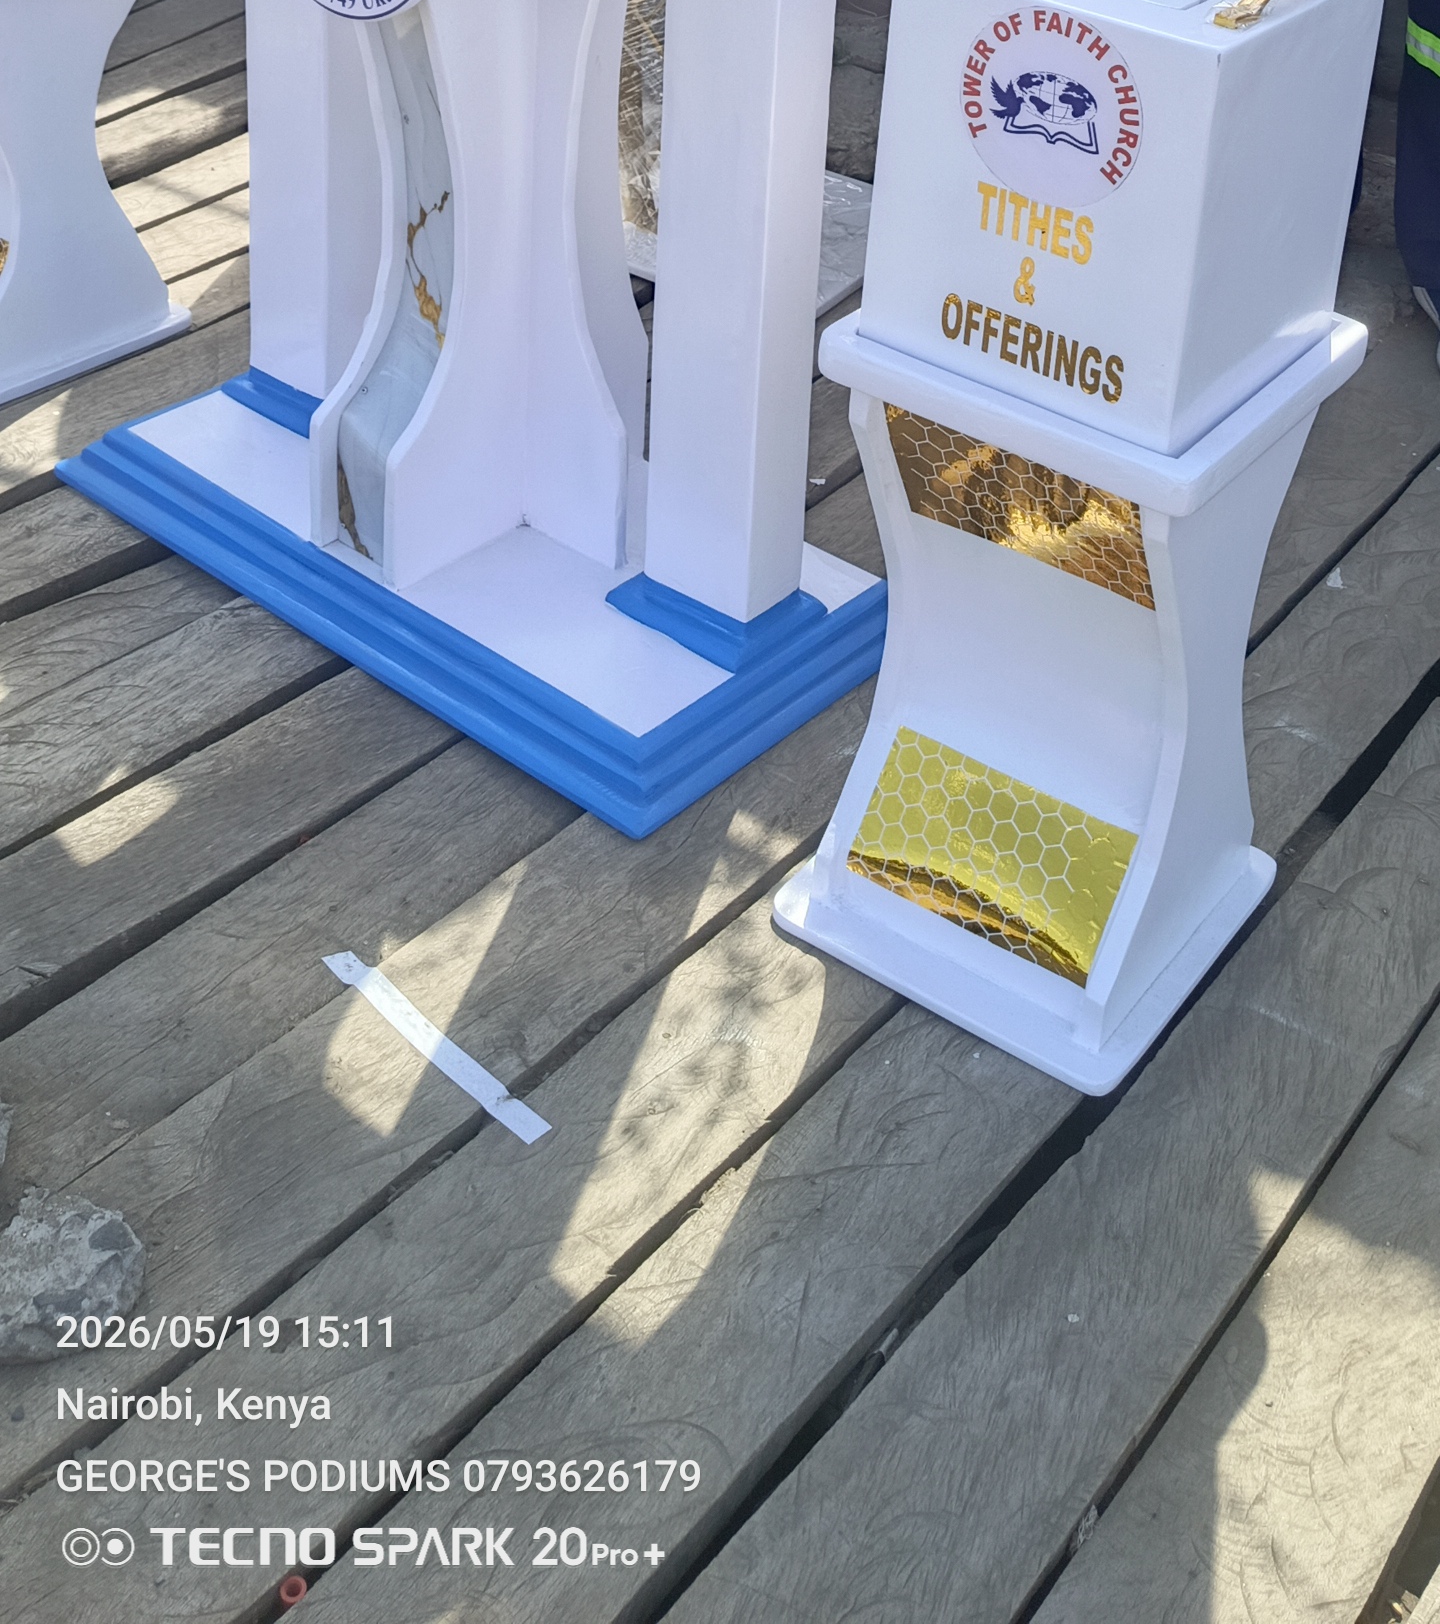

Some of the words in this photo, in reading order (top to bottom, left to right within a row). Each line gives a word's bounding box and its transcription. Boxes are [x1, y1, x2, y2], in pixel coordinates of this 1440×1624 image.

[963, 39, 996, 138] TOWER
[993, 13, 1023, 42] OF
[1033, 10, 1111, 61] FAITH
[1099, 64, 1140, 185] CHURCH
[977, 180, 1094, 265] TITHES
[1013, 256, 1036, 306] &
[941, 292, 1125, 404] OFFERINGS
